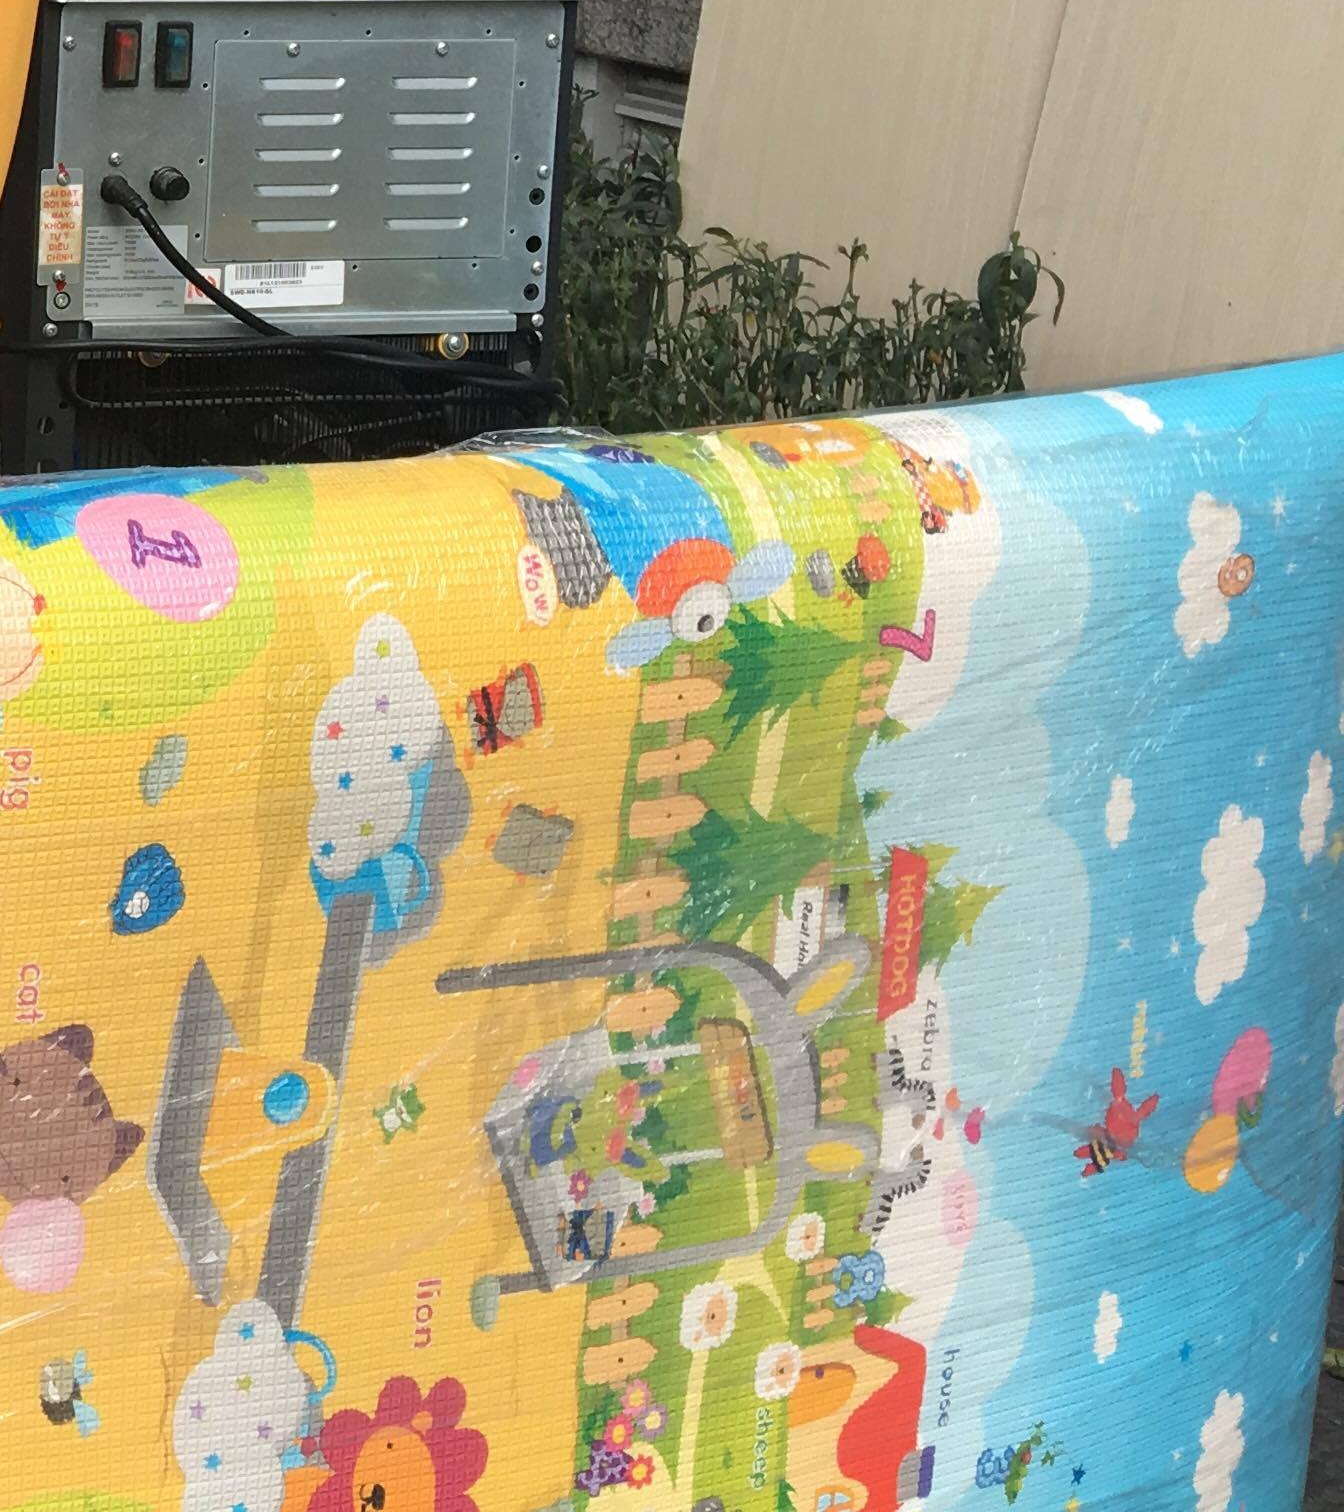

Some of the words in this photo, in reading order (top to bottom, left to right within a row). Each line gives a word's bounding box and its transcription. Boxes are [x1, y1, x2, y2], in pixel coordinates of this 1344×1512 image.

[0, 747, 42, 811] pig
[890, 874, 917, 998] HOTDOG
[16, 963, 43, 1024] cat
[920, 999, 940, 1071] zebra
[414, 1277, 442, 1350] lion
[938, 1348, 960, 1427] house
[750, 1406, 772, 1490] sheep
